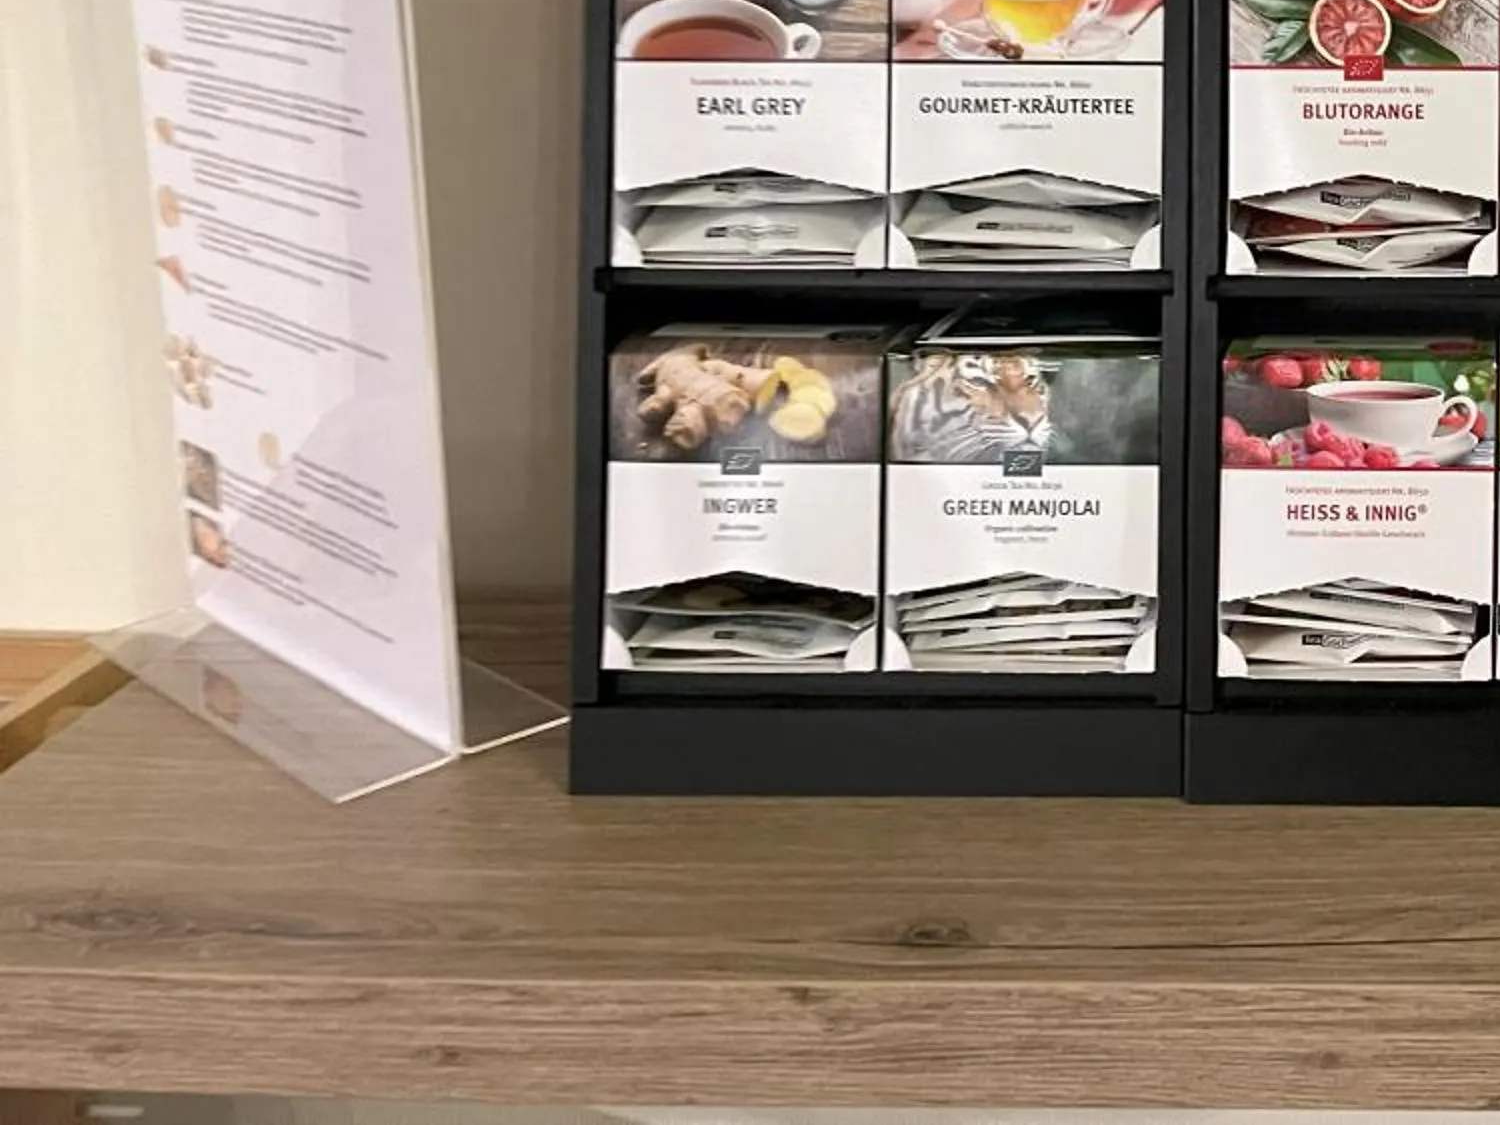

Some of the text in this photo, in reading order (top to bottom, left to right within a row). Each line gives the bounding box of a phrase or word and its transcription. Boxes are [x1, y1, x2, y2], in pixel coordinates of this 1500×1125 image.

[697, 97, 806, 116] EARL GREY
[919, 95, 1135, 114] GOURMET-KRÄUTERTEE
[1303, 102, 1425, 120] BLUTORANGE
[703, 498, 778, 514] INGWER
[943, 499, 1101, 517] GREEN MANJOLAI
[1287, 504, 1341, 521] HEISS
[1345, 504, 1360, 521] &
